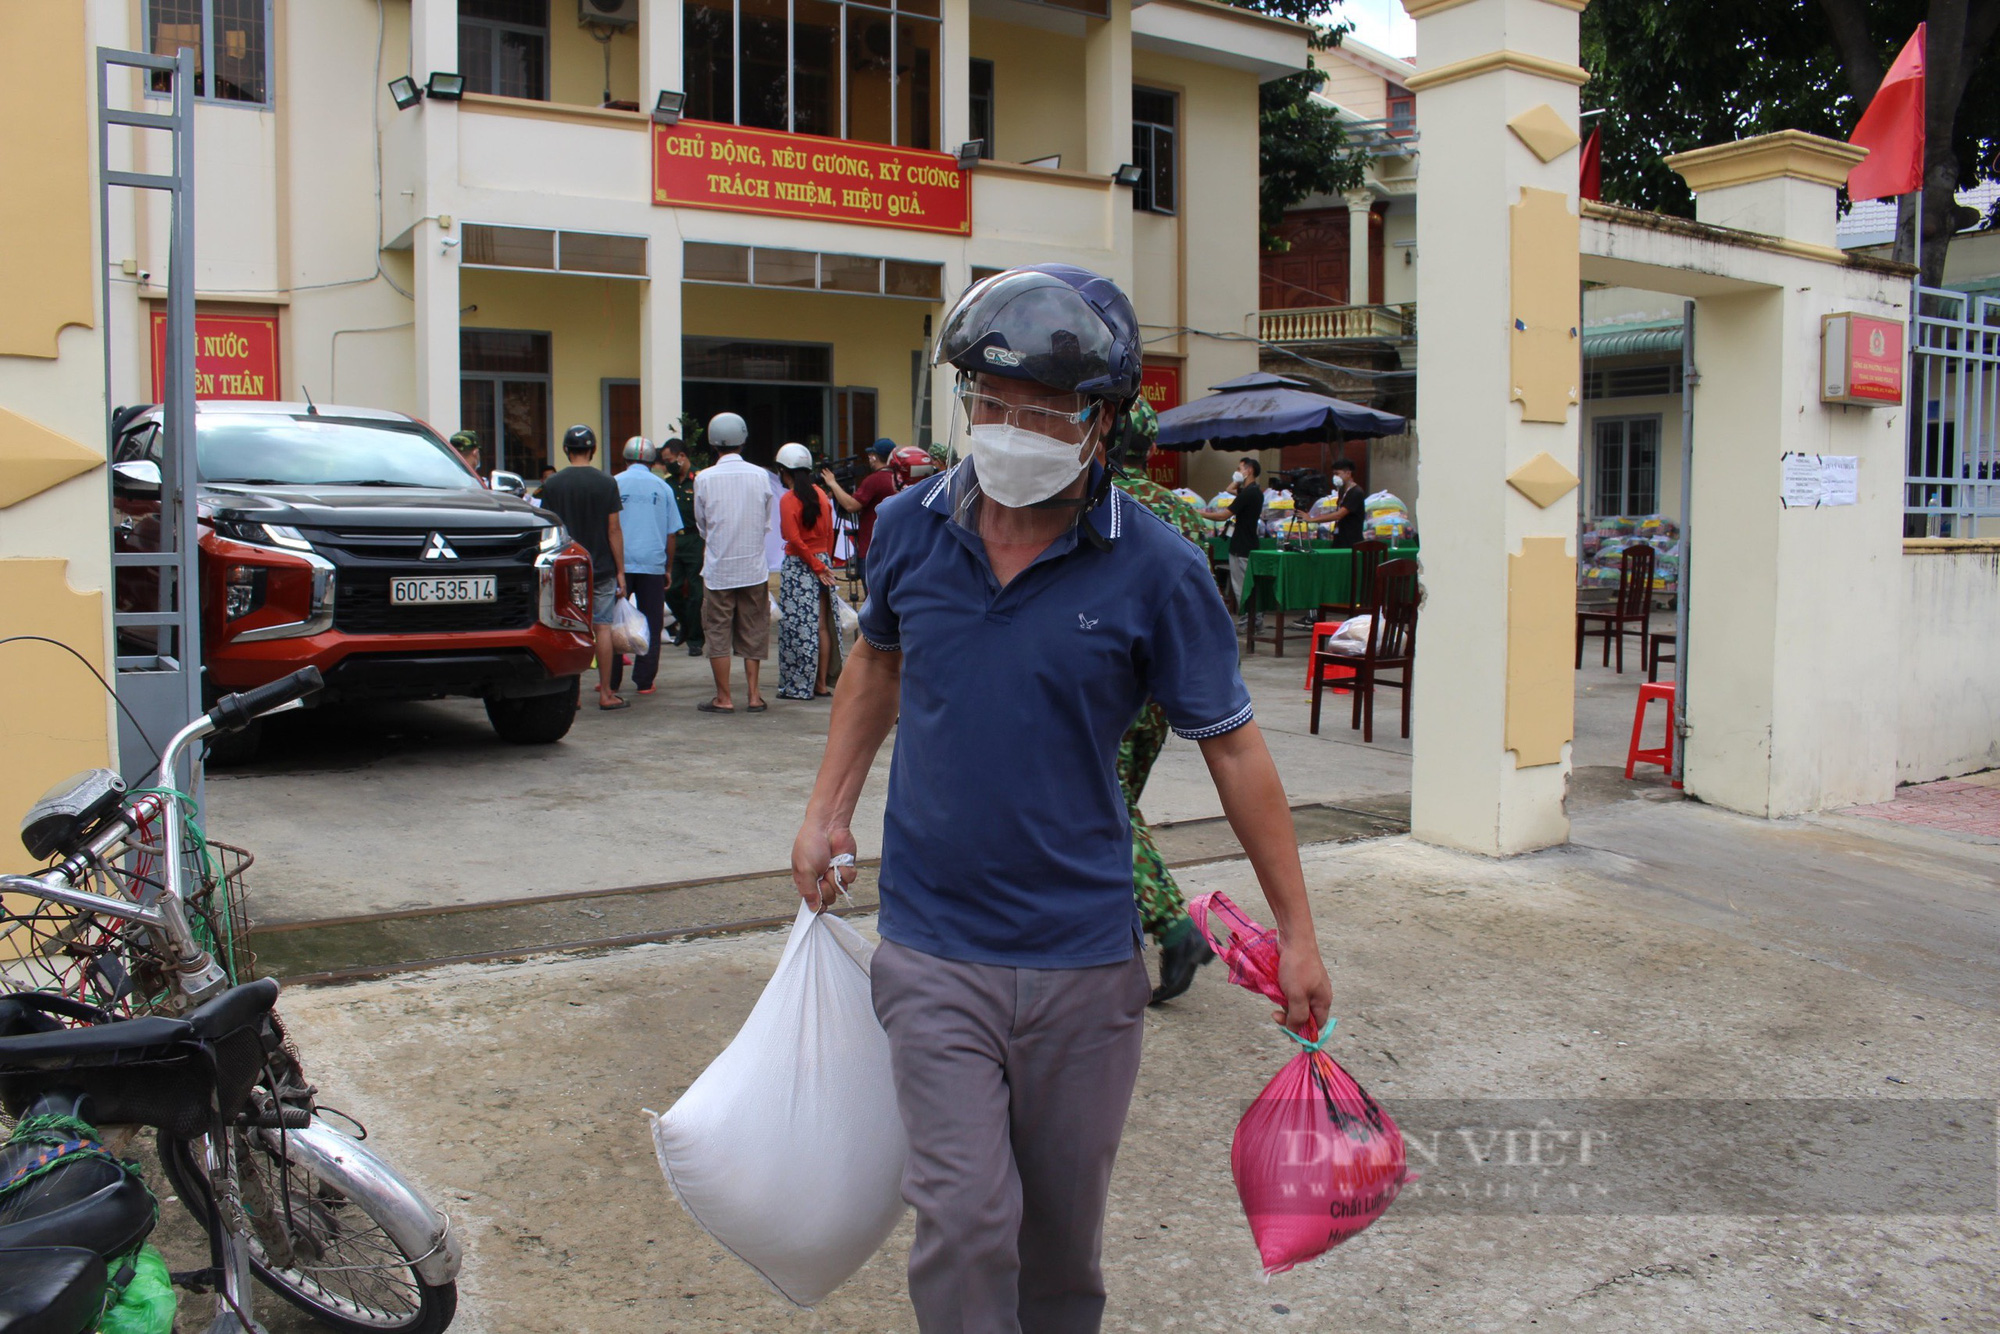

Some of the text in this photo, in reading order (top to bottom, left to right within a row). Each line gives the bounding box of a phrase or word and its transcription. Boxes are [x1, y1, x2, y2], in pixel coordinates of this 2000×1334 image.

[666, 132, 960, 190] CHỦ ĐỘNG, NÊU GƯƠNG, KỶ CƯƠNG
[707, 172, 925, 216] TRÁCH NHIỆM, HIỆU QUẢ.
[204, 332, 249, 358] NƯỚC
[219, 370, 264, 396] THÂN
[1142, 382, 1167, 401] NGÀY
[395, 580, 493, 601] 60C-535.14
